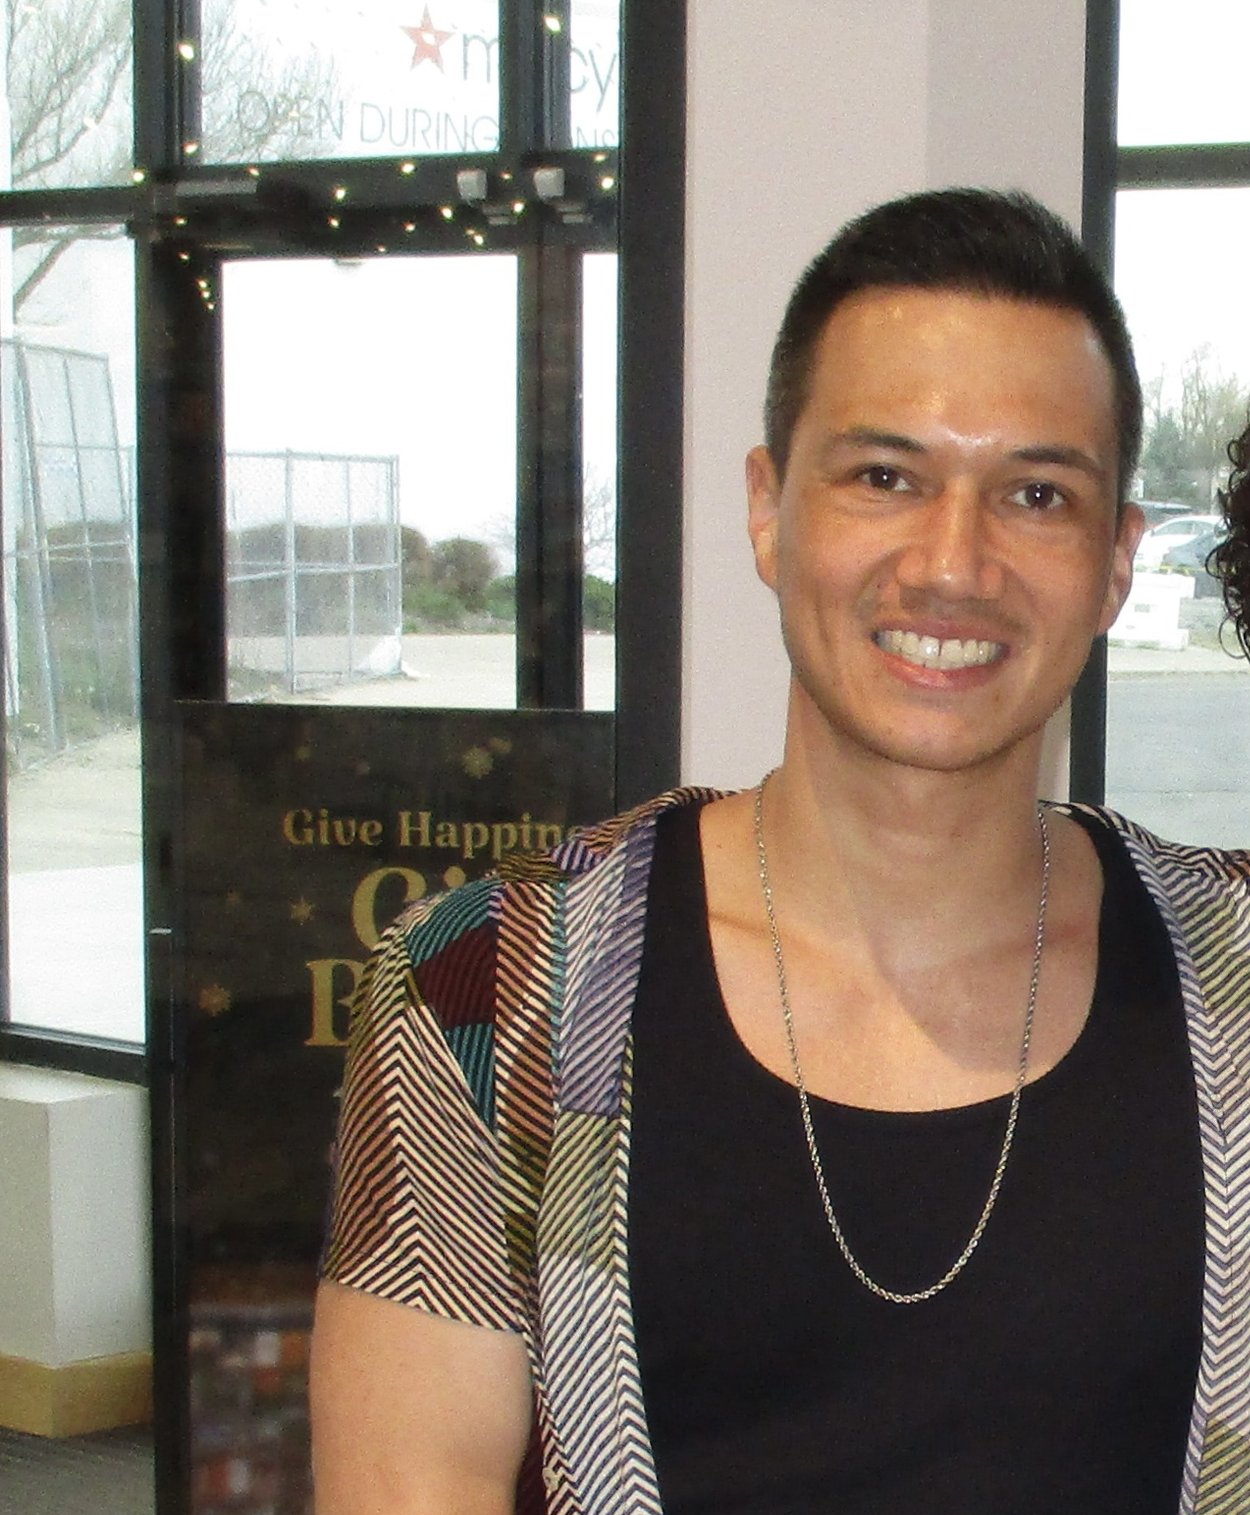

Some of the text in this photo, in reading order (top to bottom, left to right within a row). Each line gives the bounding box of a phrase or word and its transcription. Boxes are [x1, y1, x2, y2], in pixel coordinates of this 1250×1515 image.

[360, 102, 500, 152] DURING
[283, 807, 584, 859] Give Happin
